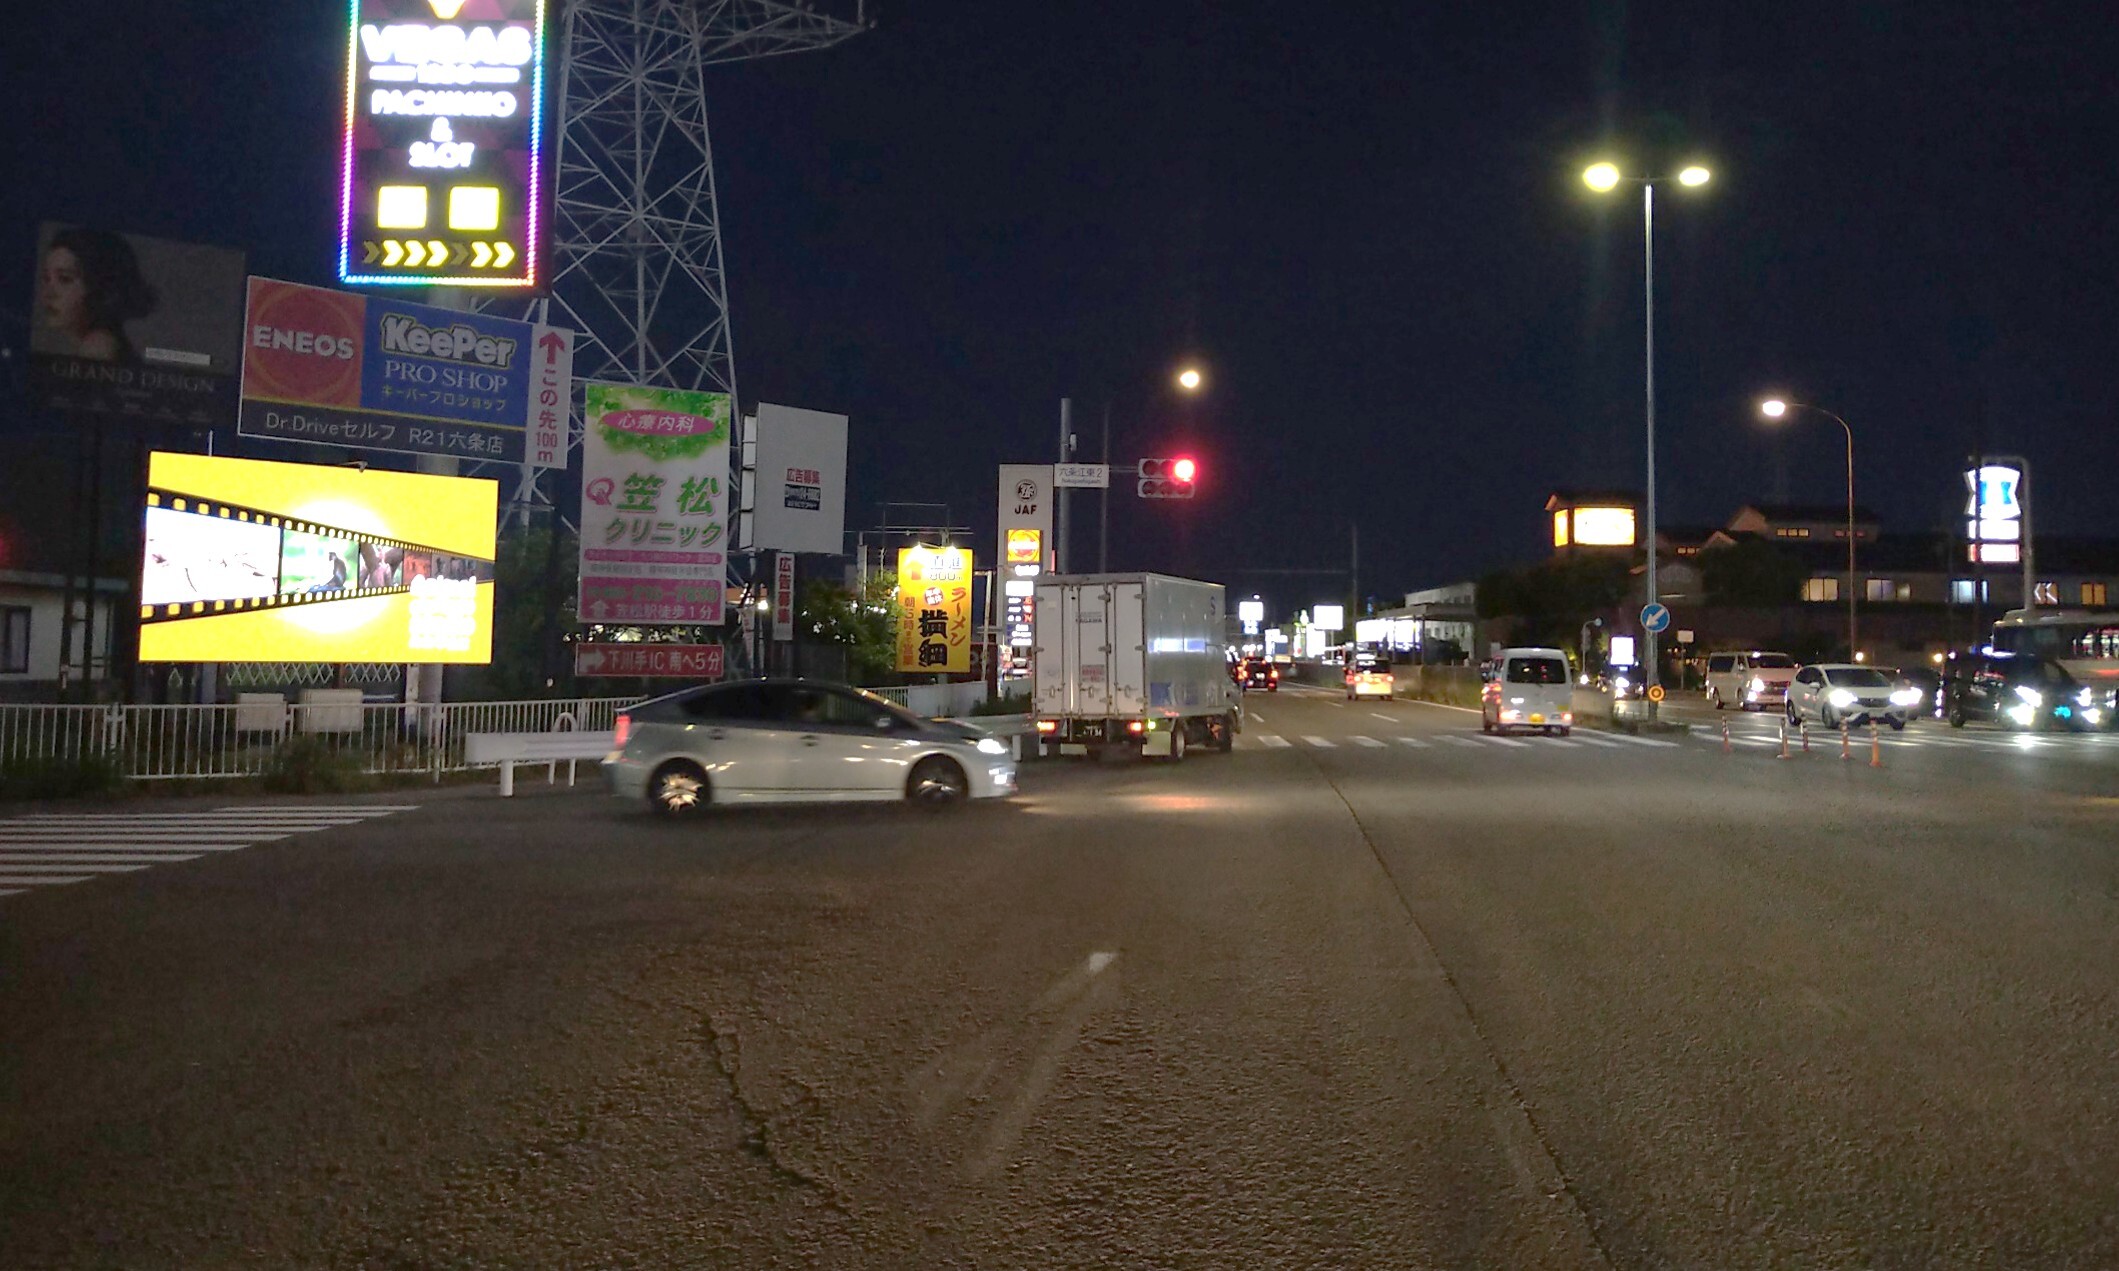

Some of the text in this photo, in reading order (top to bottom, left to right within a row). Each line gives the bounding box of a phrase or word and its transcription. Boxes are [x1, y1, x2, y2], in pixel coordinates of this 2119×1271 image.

[408, 141, 475, 168] SLOT
[252, 324, 355, 361] ENEOS
[380, 313, 518, 367] KeePer
[52, 359, 134, 384] GRAND
[141, 368, 216, 393] DESIGN
[383, 359, 509, 393] PRO SHOP
[380, 384, 507, 413] キーパープロショップ
[617, 413, 696, 433] 心療内科
[408, 426, 505, 455] R21六条店
[615, 470, 723, 516] 笠松
[786, 467, 821, 485] 広告募集
[1014, 504, 1037, 515] JAF
[604, 515, 725, 549] クリニック
[777, 557, 793, 624] 広告募集
[949, 586, 967, 647] ラーメン
